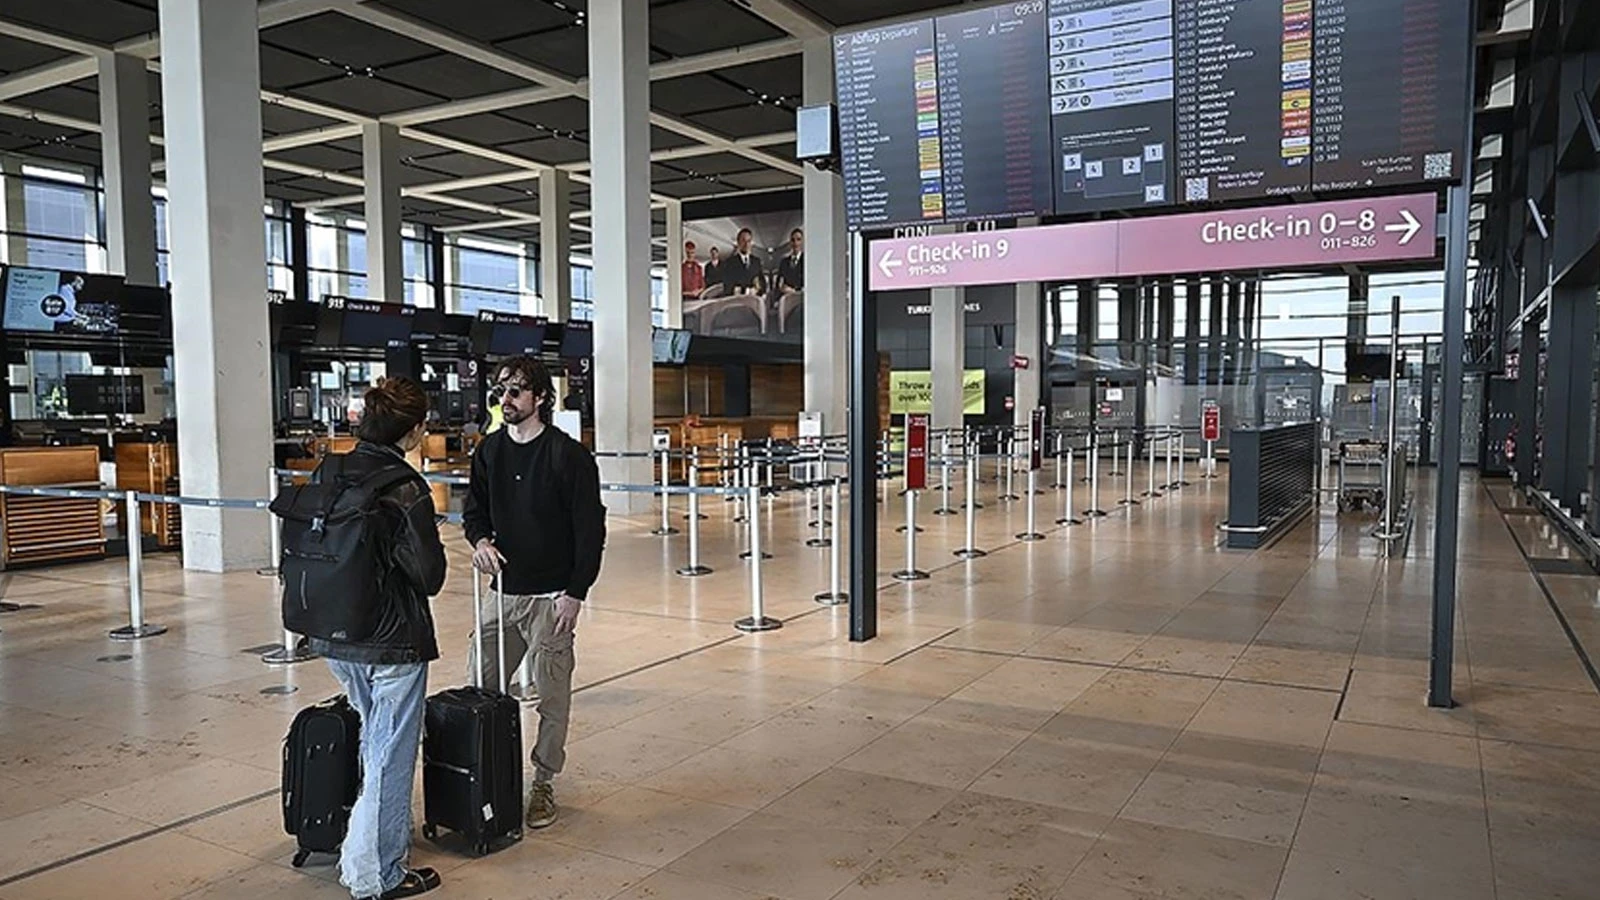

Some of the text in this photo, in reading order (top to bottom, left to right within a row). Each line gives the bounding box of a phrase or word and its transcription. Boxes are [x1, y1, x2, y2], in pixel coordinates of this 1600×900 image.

[1202, 215, 1310, 243] Check-in
[907, 238, 1009, 264] Check-in 9
[468, 360, 478, 376] 9
[580, 358, 590, 374] 9
[898, 381, 925, 390] Throw
[898, 393, 916, 402] over
